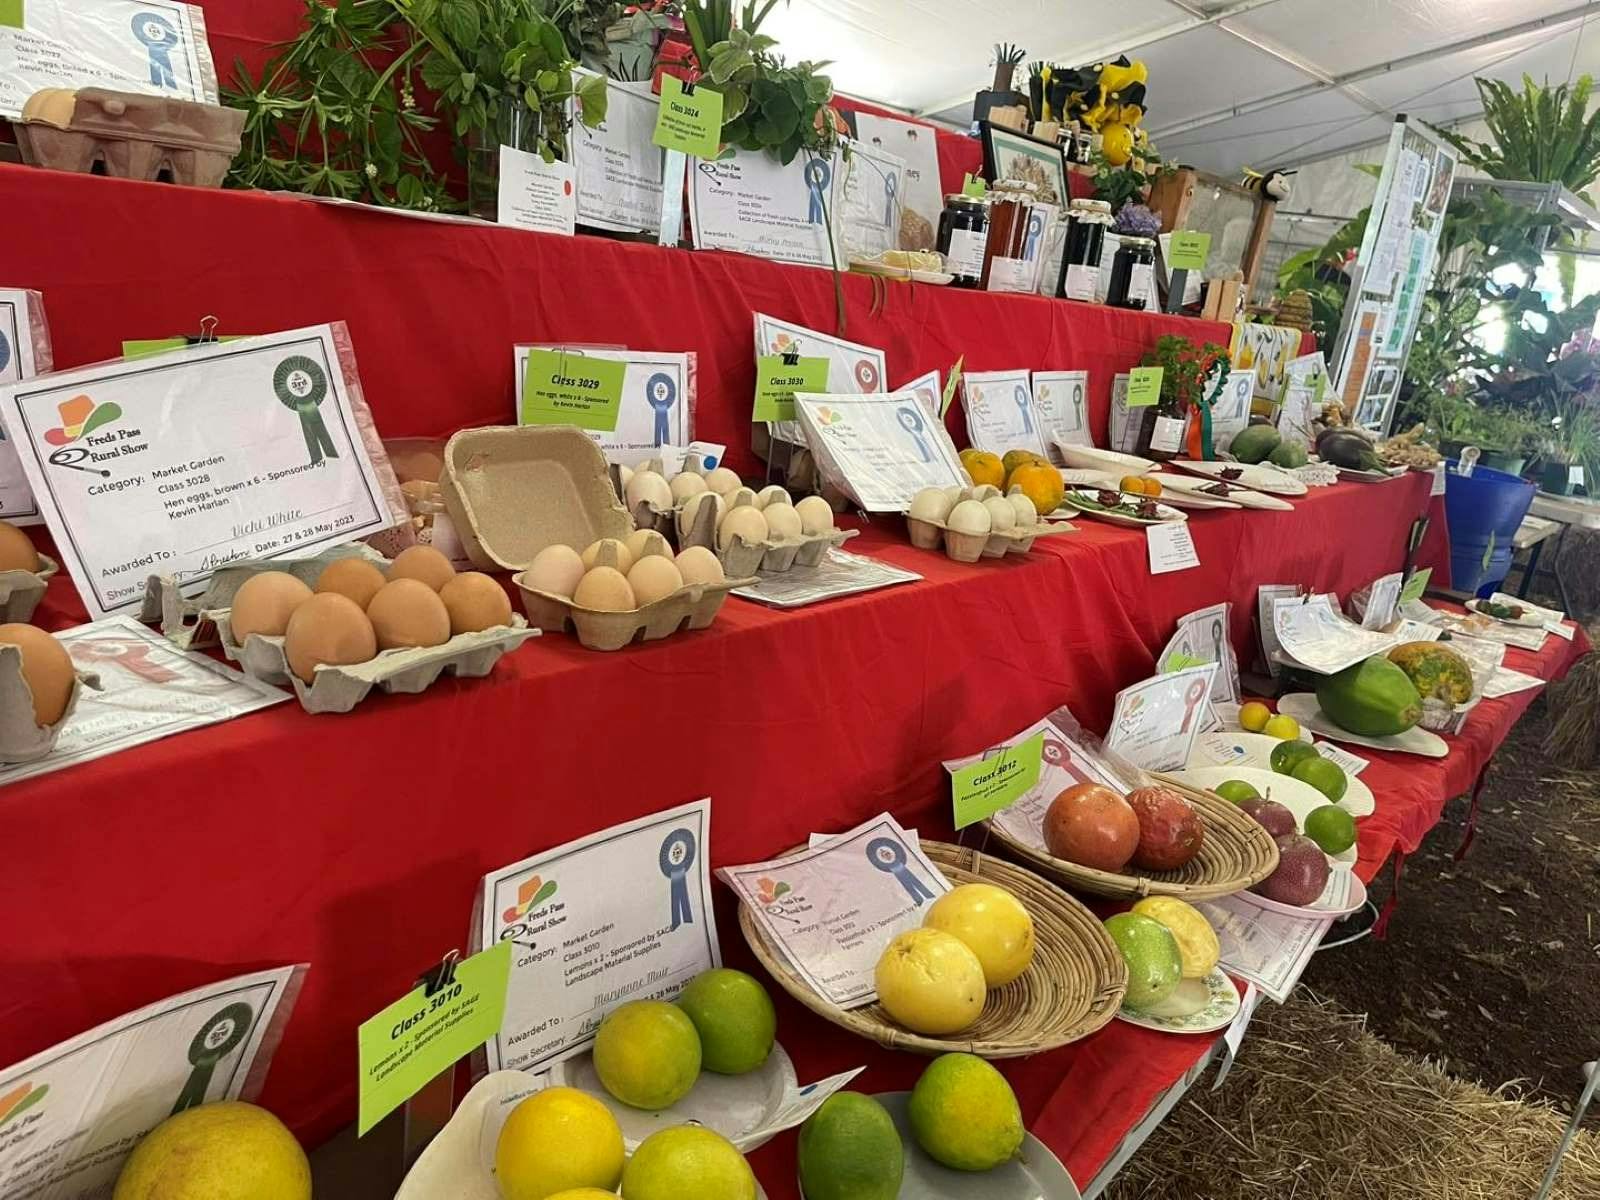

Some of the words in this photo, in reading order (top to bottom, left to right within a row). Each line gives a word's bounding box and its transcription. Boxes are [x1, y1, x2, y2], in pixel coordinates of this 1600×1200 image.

[671, 101, 683, 113] Class
[684, 106, 700, 118] 3024
[738, 200, 750, 208] Class
[551, 374, 576, 386] Class
[577, 377, 600, 390] 3029
[787, 377, 804, 385] 3030
[86, 433, 117, 447] Freds
[117, 428, 141, 440] Pass
[89, 449, 120, 463] Rural
[121, 443, 149, 456] Show
[88, 476, 145, 496] Category:
[152, 464, 188, 480] Market
[189, 455, 225, 471] Garden
[158, 482, 185, 495] Class
[186, 474, 211, 488] 3028
[163, 497, 185, 510] Hen
[187, 490, 214, 505] eggs,
[214, 481, 245, 496] brown
[254, 476, 261, 485] 6
[267, 462, 314, 481] Sponsored
[168, 507, 196, 521] Kevin
[198, 497, 230, 513] Harlan
[101, 554, 153, 578] Awarded
[267, 509, 303, 527] White
[255, 541, 281, 553] Date:
[282, 535, 293, 545] 27
[294, 532, 301, 540] &
[303, 528, 314, 538] 28
[314, 523, 333, 534] May
[334, 515, 355, 527] 2023
[107, 584, 136, 601] Show
[973, 771, 995, 786] Class
[996, 760, 1017, 776] 3012
[527, 921, 547, 936] Rural
[548, 916, 567, 928] Show
[528, 908, 548, 922] Freds
[518, 946, 557, 967] Category:
[563, 934, 589, 949] Market
[589, 923, 614, 938] Garden
[563, 950, 582, 962] Class
[583, 942, 600, 954] 3010
[564, 959, 593, 976] Lemons
[610, 937, 646, 957] Sponsored
[646, 934, 655, 942] by
[565, 966, 603, 987] Landscape
[604, 953, 633, 970] Material
[634, 941, 662, 957] Supplies
[391, 1009, 425, 1040] Class
[429, 983, 462, 1013] 3010
[369, 1052, 397, 1075] Lemons
[414, 1012, 450, 1040] Sponsored
[376, 1049, 413, 1082] Landscape
[415, 1025, 444, 1051] Material
[445, 1007, 473, 1029] Supplies
[508, 1022, 547, 1046] Awarded
[507, 1054, 529, 1066] Show
[530, 1036, 567, 1057] Secretary:
